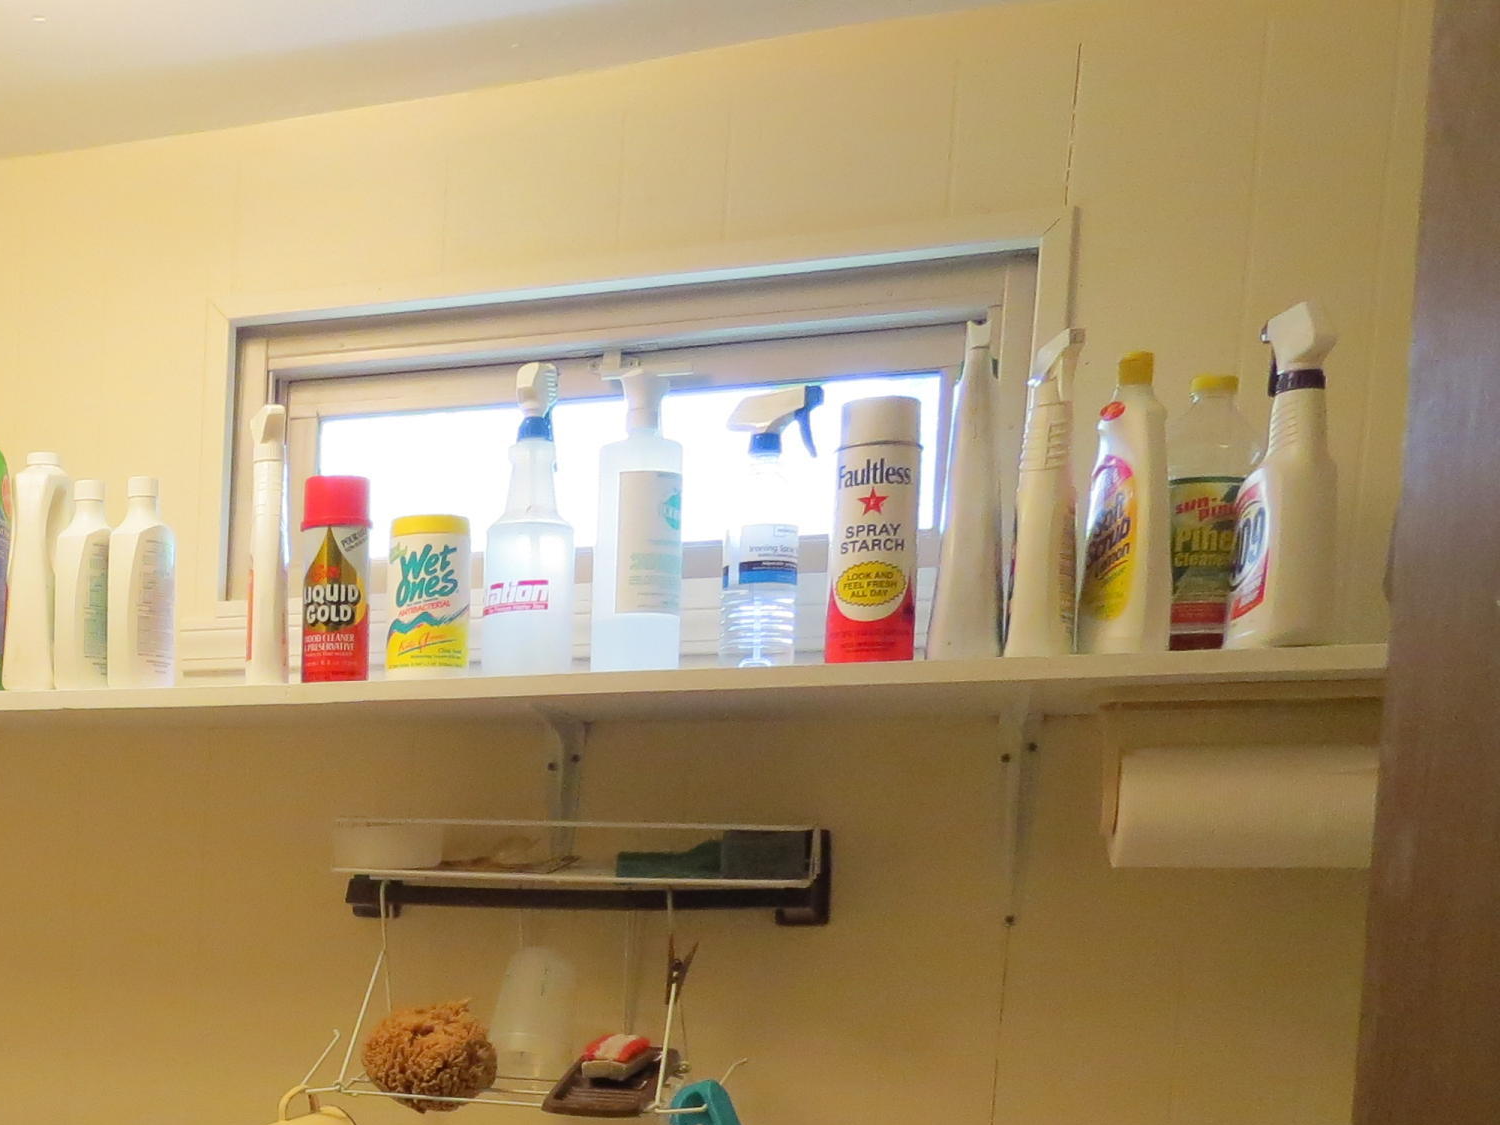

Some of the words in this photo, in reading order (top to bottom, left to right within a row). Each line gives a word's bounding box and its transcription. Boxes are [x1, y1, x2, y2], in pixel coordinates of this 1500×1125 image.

[837, 458, 911, 490] Faultless
[846, 523, 901, 539] SPRAY
[840, 538, 905, 555] STARCH
[400, 543, 457, 579] Wet
[847, 572, 871, 581] LOOK
[874, 571, 894, 580] AND
[396, 569, 458, 608] Ones
[843, 581, 865, 591] FEEL
[867, 579, 898, 589] FRESH
[850, 589, 867, 598] ALL
[869, 588, 889, 597] DAY
[303, 584, 360, 605] LIQUID
[306, 604, 353, 624] GOLD
[399, 599, 452, 617] ANTIBACTERIAL
[322, 632, 355, 643] CLEANER
